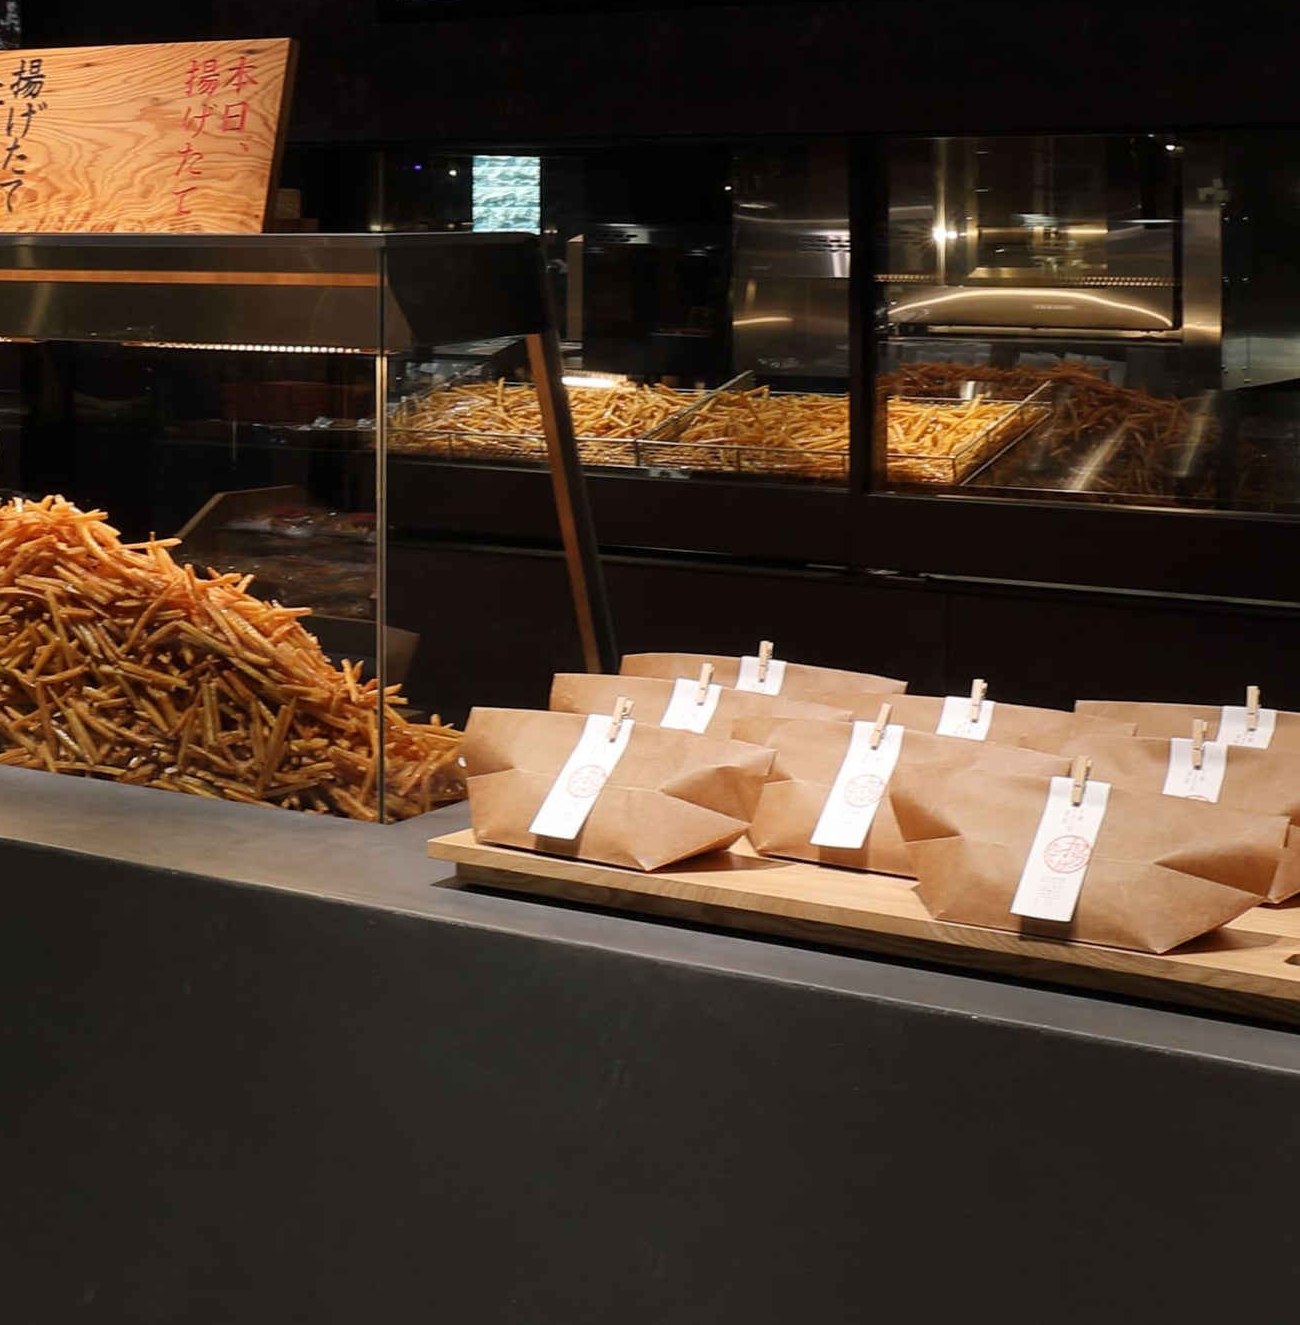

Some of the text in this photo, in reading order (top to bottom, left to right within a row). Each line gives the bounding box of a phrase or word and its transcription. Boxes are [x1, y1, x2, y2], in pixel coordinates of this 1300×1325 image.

[0, 58, 48, 212] 揚げたて
[172, 58, 221, 215] 揚げたて
